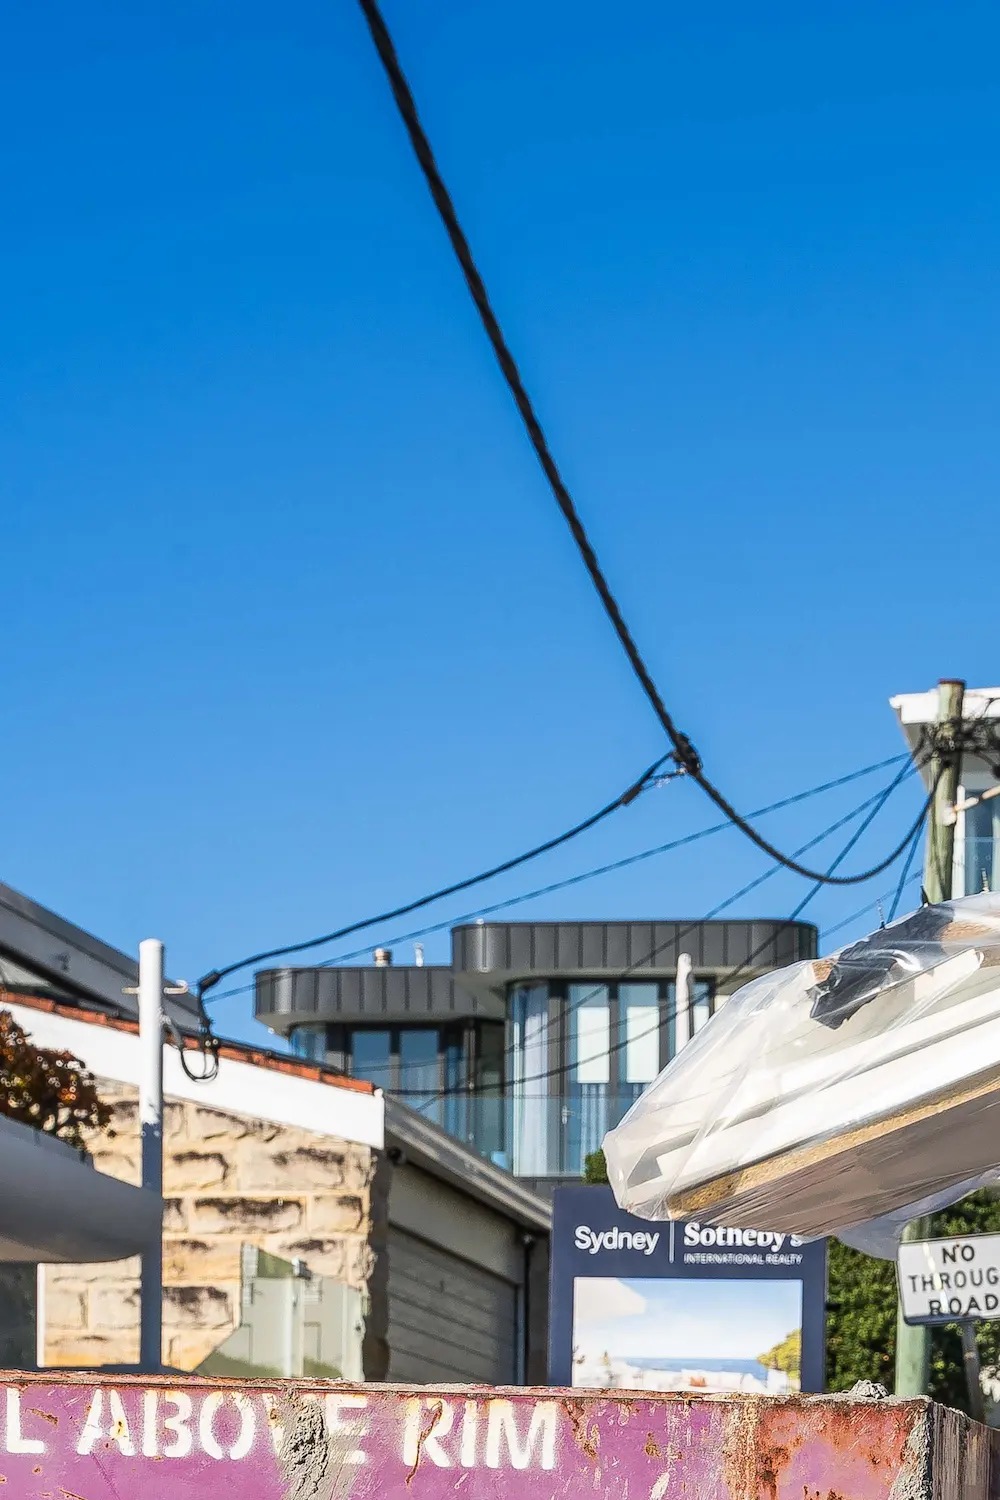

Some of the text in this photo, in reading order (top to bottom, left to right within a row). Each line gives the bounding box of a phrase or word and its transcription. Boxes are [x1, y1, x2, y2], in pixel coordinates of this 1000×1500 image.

[575, 1221, 803, 1254] Sydney Sothebys
[684, 1253, 803, 1265] INTERNATIONAL REALTY
[942, 1244, 975, 1264] NO
[928, 1293, 999, 1317] ROAD
[402, 1397, 558, 1470] RIM
